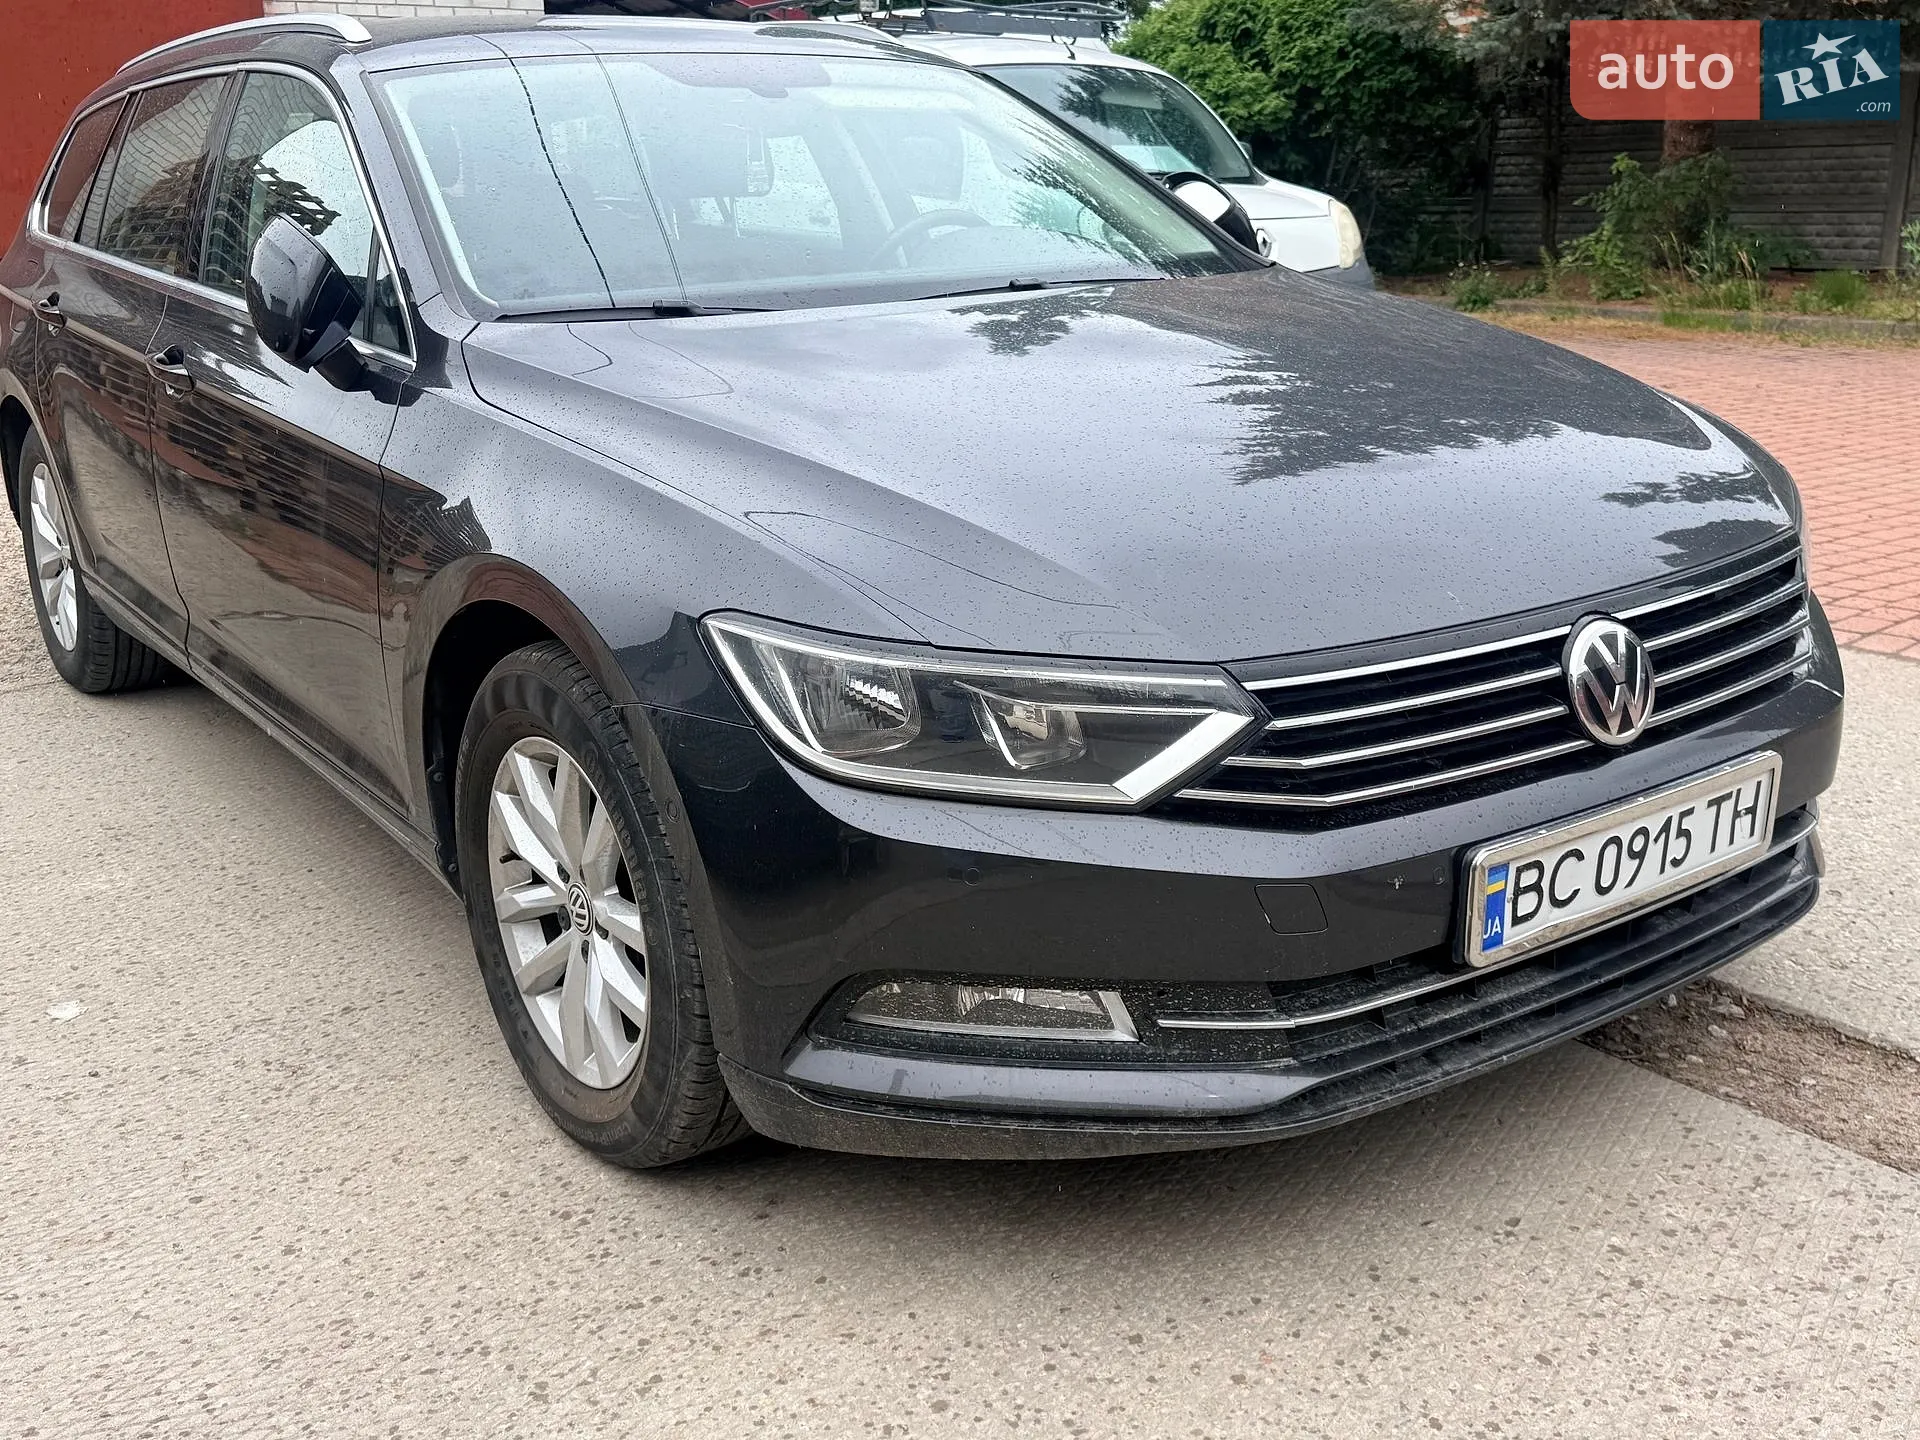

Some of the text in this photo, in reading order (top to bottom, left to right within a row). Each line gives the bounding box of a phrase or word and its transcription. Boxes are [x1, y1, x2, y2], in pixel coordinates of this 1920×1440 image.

[1510, 780, 1762, 928] BC 0915 TH
